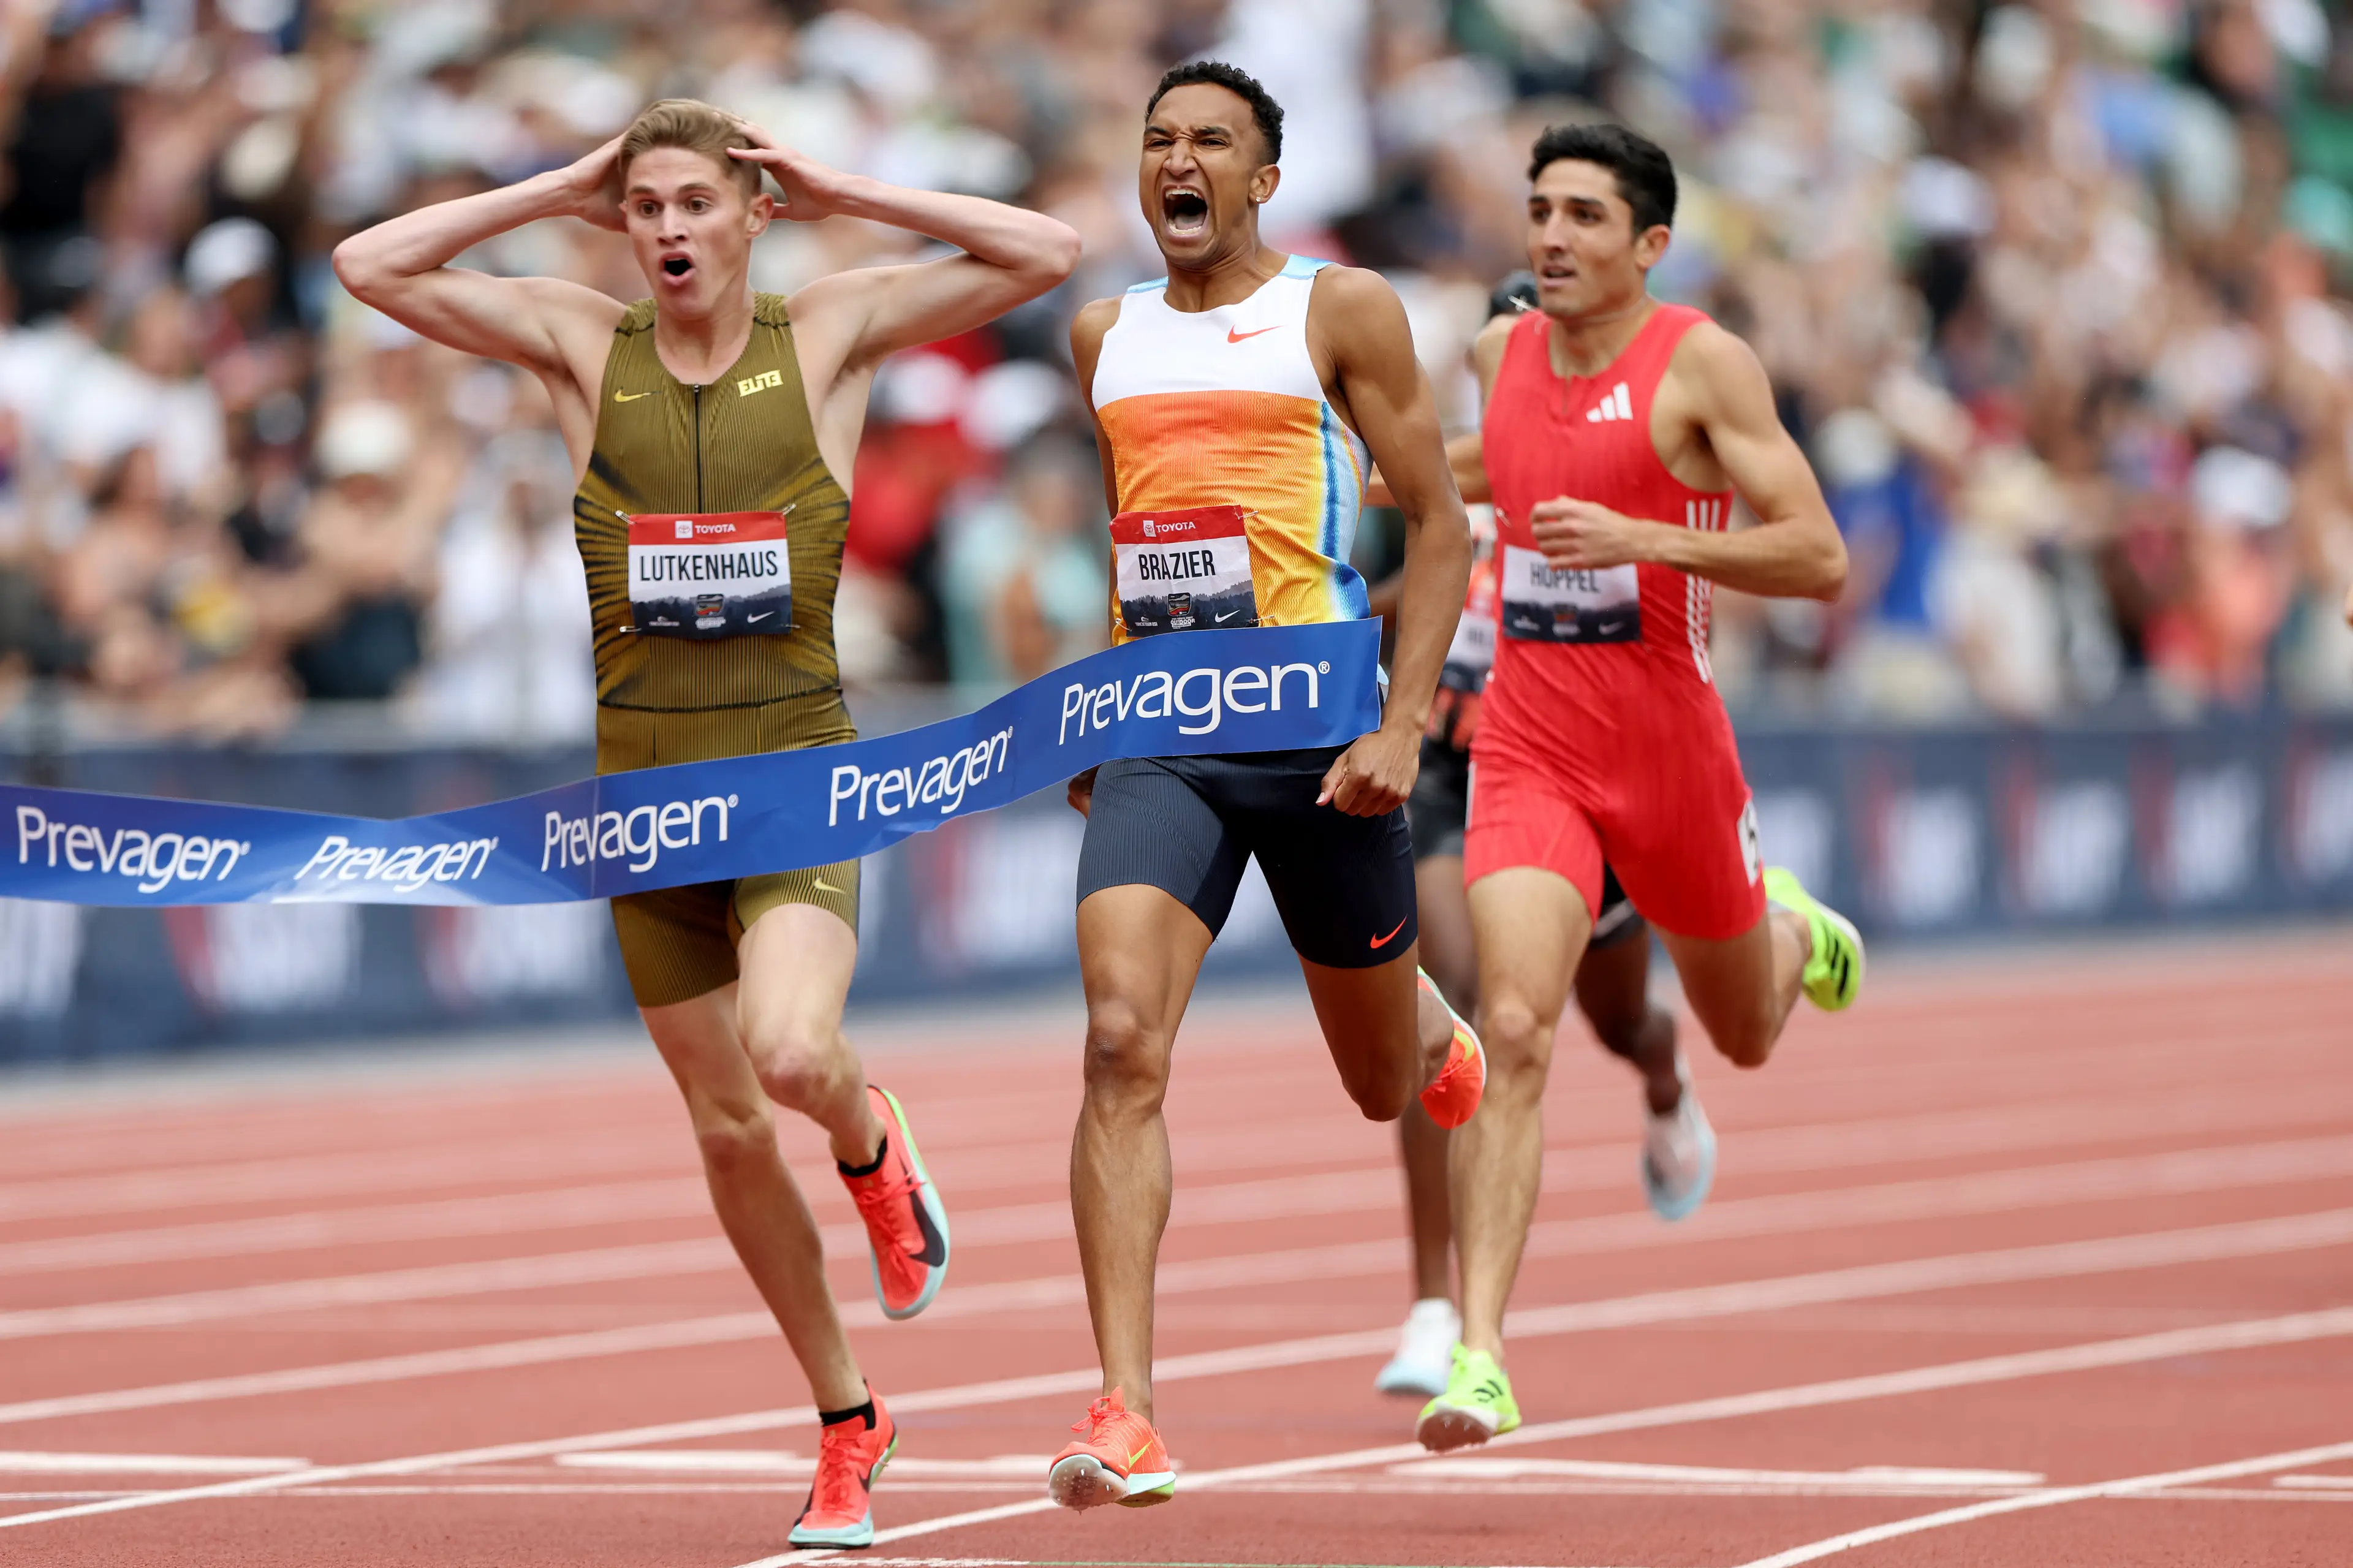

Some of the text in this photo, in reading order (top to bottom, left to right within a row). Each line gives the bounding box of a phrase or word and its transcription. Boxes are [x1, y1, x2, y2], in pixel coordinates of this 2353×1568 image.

[695, 524, 736, 534] TOYOTA
[1156, 521, 1195, 532] TOYOTA
[640, 550, 778, 581] LUTKENHAUS
[1139, 550, 1216, 580] BRAZIER
